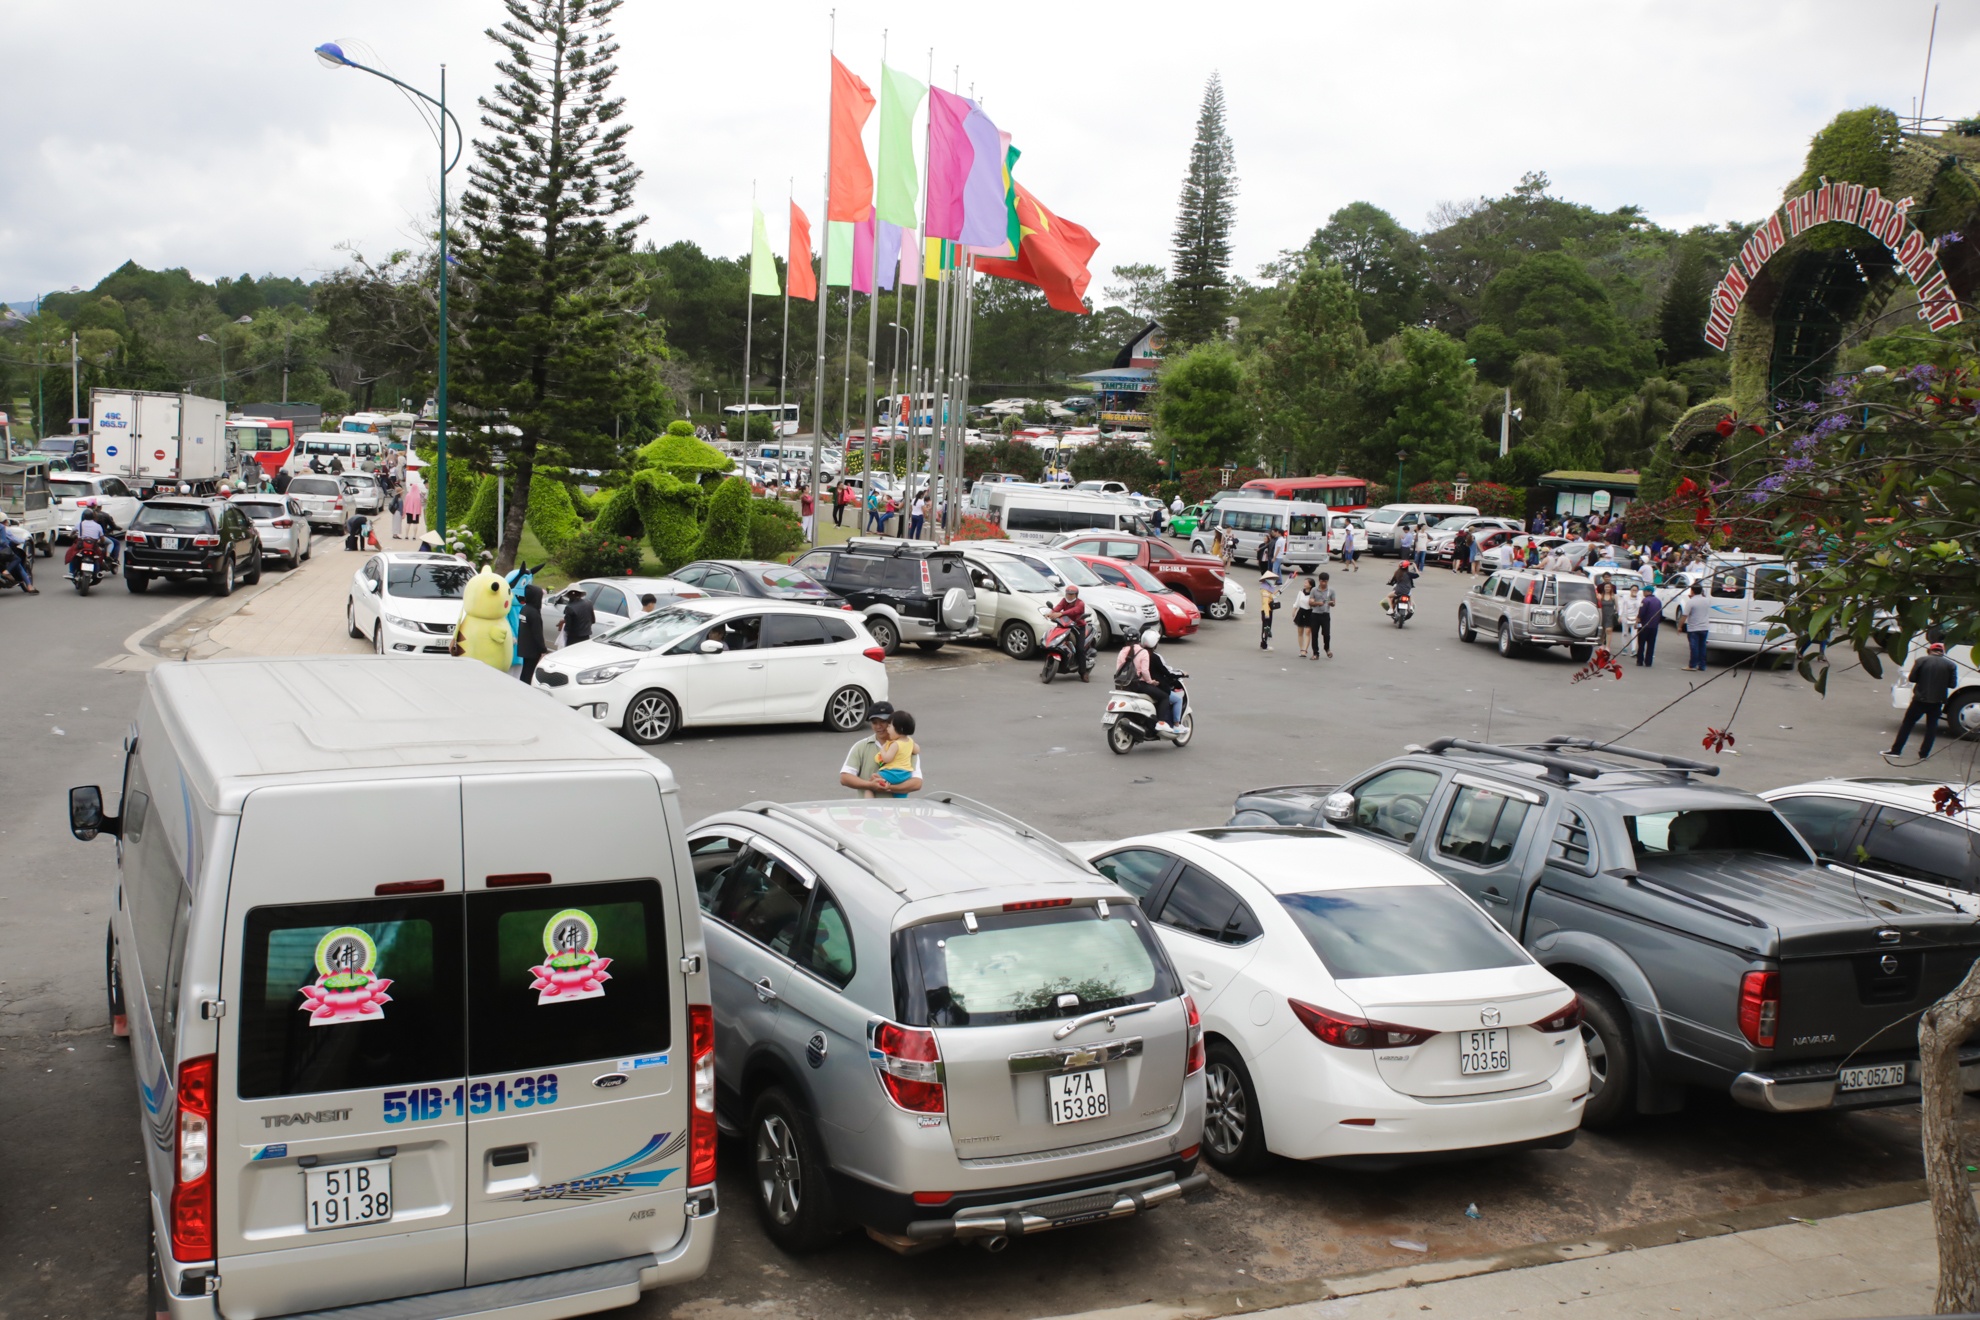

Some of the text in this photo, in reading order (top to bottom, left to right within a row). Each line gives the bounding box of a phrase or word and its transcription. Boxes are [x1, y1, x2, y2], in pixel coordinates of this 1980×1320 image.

[1739, 212, 1785, 279] HOA
[1785, 175, 1863, 238] THÀNH
[1859, 187, 1915, 250] PHỐ
[1916, 269, 1963, 332] LẠT
[105, 412, 121, 420] 49C
[1471, 1031, 1497, 1052] 51F
[1792, 1034, 1836, 1046] NAVARA
[1462, 1050, 1508, 1073] 703.56
[600, 1078, 622, 1088] Ford
[1063, 1072, 1094, 1097] 47A
[1841, 1066, 1904, 1088] 43C-052.76
[260, 1108, 353, 1128] TRANSIT
[1054, 1093, 1107, 1122] 153.88
[326, 1167, 370, 1196] 51B
[522, 1172, 631, 1202] LUXURY
[311, 1192, 389, 1226] 191.38
[629, 1208, 657, 1222] ABS
